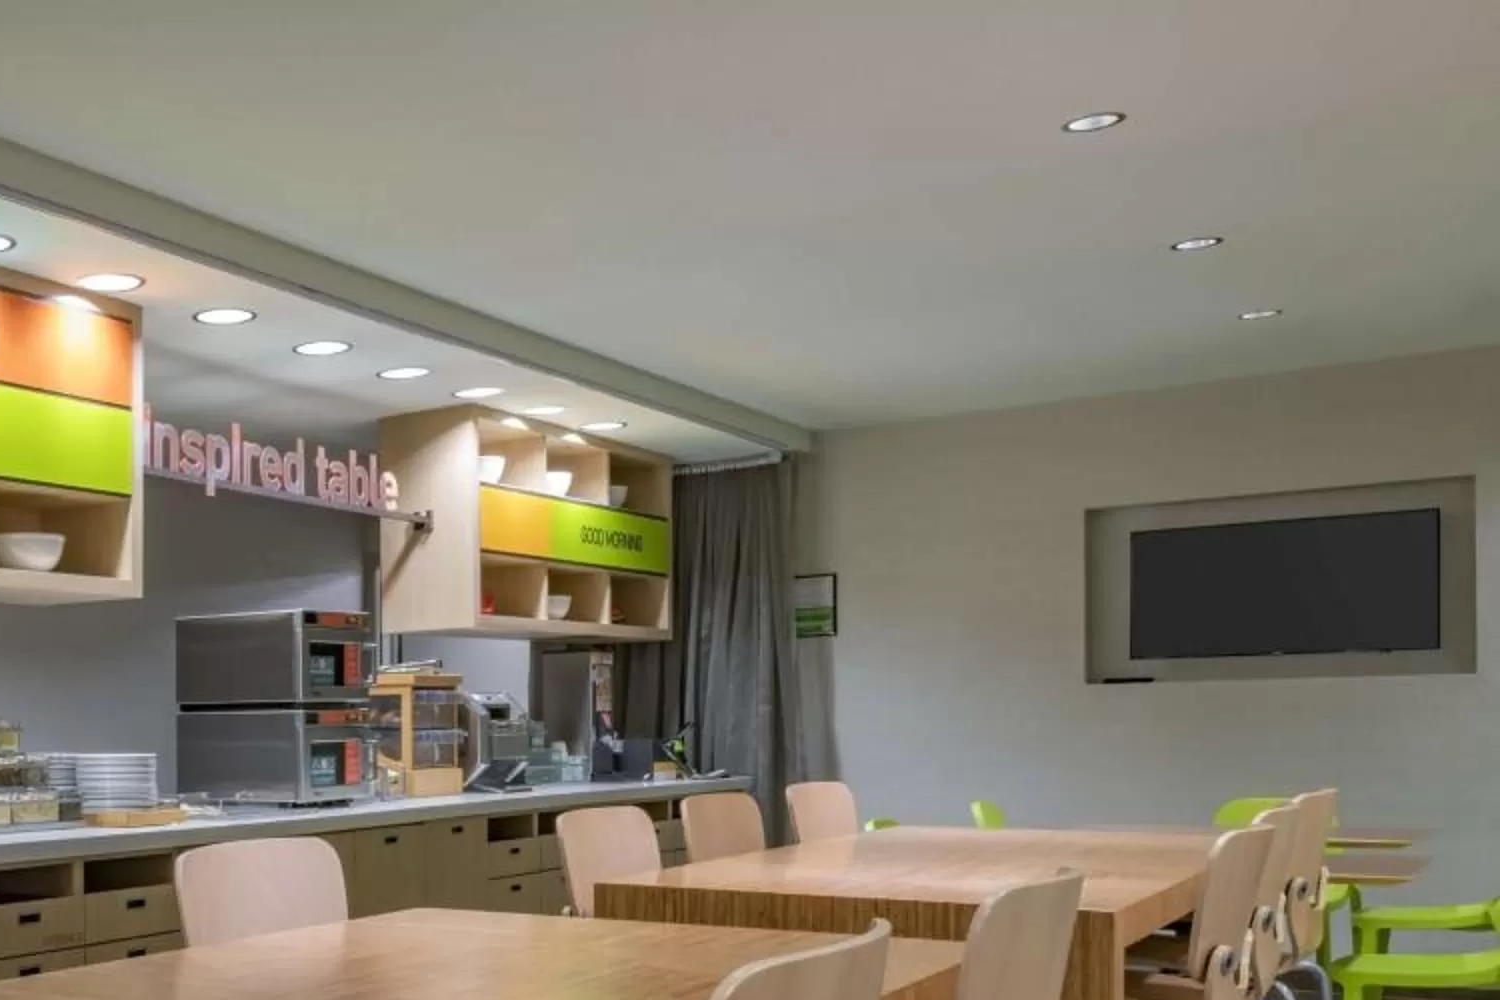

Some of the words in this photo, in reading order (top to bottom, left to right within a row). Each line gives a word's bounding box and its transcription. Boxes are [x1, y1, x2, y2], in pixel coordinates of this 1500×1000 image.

[315, 446, 399, 512] table
[580, 525, 604, 547] GOOD
[605, 529, 643, 552] MORNING
